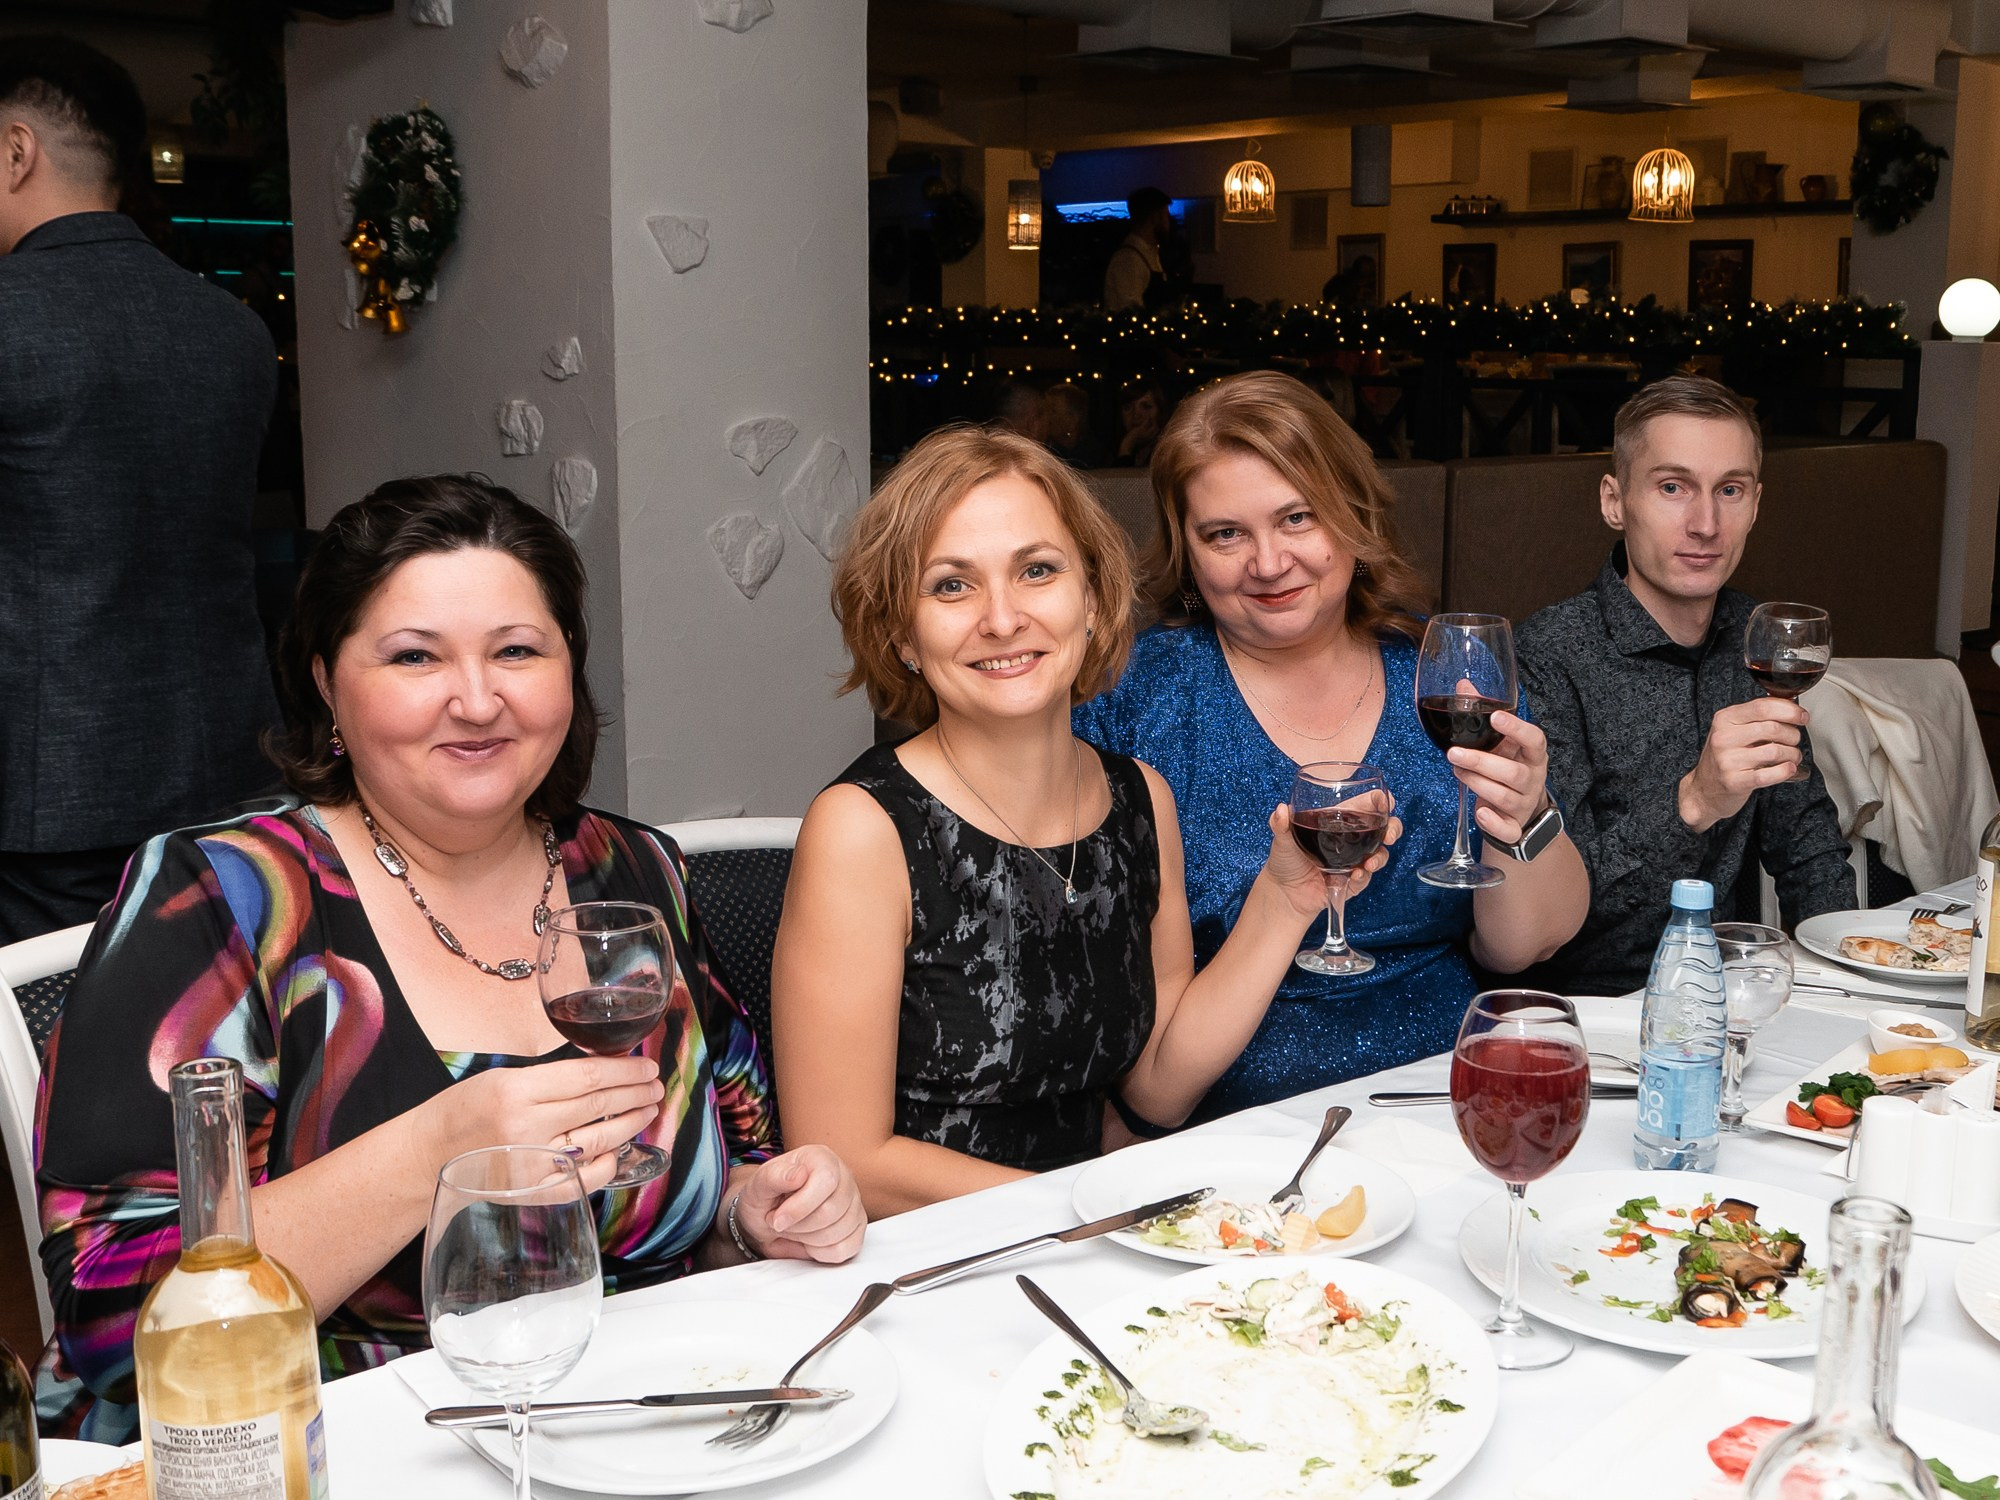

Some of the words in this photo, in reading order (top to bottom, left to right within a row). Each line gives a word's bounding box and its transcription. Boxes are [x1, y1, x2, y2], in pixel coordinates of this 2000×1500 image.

[163, 1425, 198, 1437] ТРОЗО
[202, 1422, 257, 1437] ВЕРДЕХО
[169, 1436, 201, 1446] TROZO
[204, 1432, 252, 1446] VERDEJO
